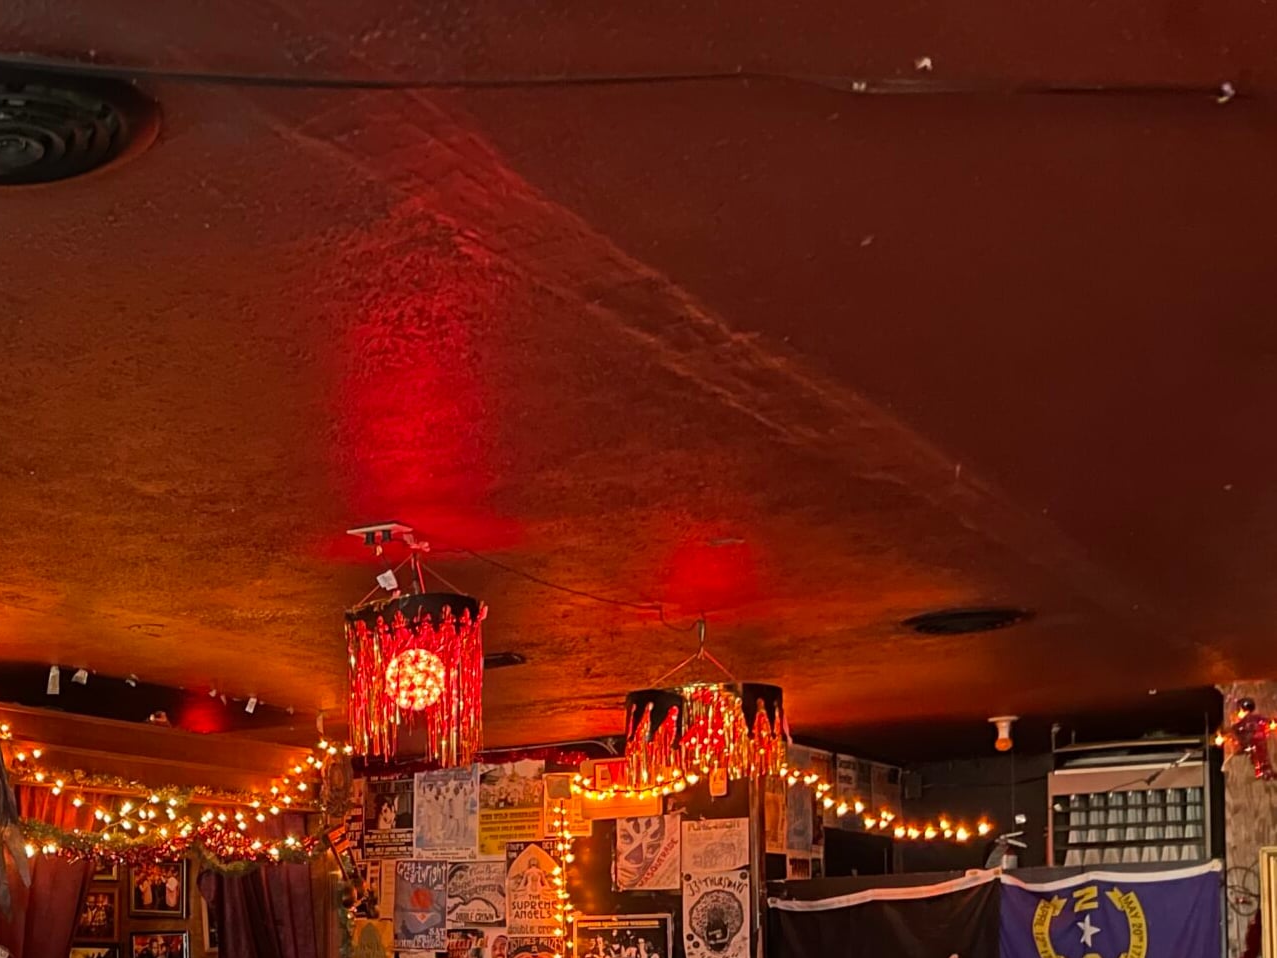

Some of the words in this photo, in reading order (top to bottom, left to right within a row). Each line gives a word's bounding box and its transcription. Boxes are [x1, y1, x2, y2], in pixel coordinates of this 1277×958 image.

[1073, 885, 1098, 913] N
[1124, 895, 1141, 920] MAY
[513, 910, 553, 920] ANGELS
[1034, 903, 1050, 927] APRIL
